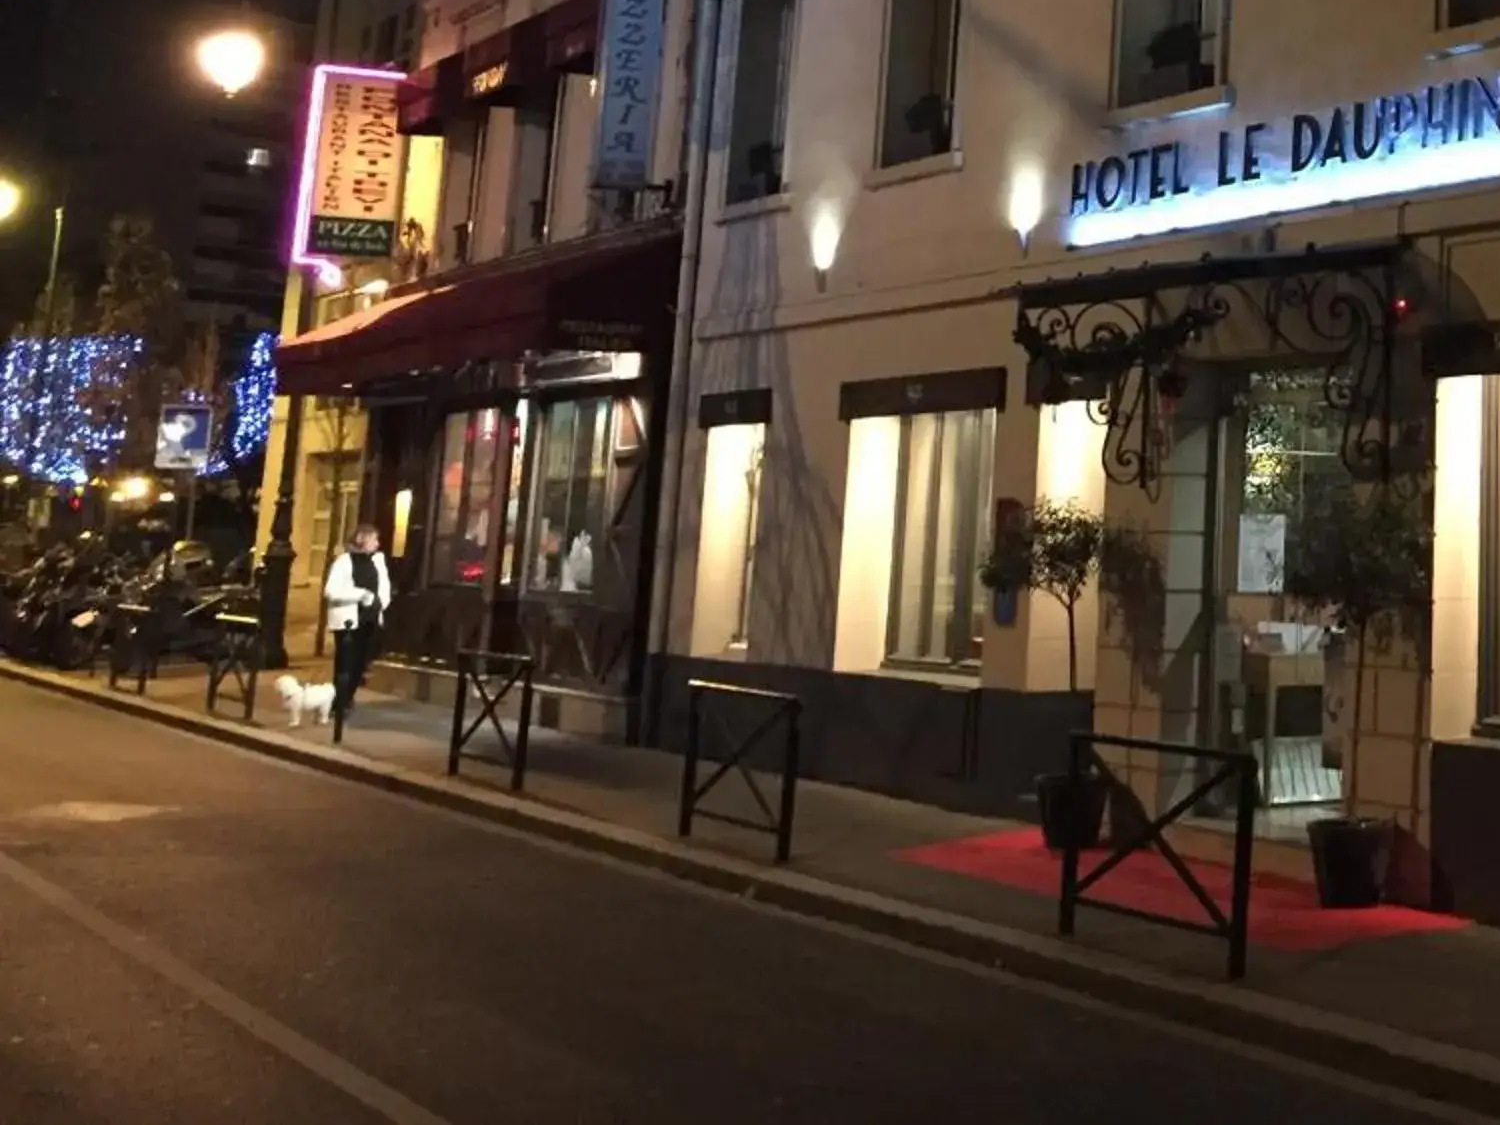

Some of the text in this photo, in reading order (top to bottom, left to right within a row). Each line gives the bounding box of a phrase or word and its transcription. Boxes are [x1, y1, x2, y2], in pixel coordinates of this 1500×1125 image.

[1069, 141, 1190, 217] HOTEL
[1216, 122, 1267, 187] LE
[318, 220, 389, 240] PIZZA
